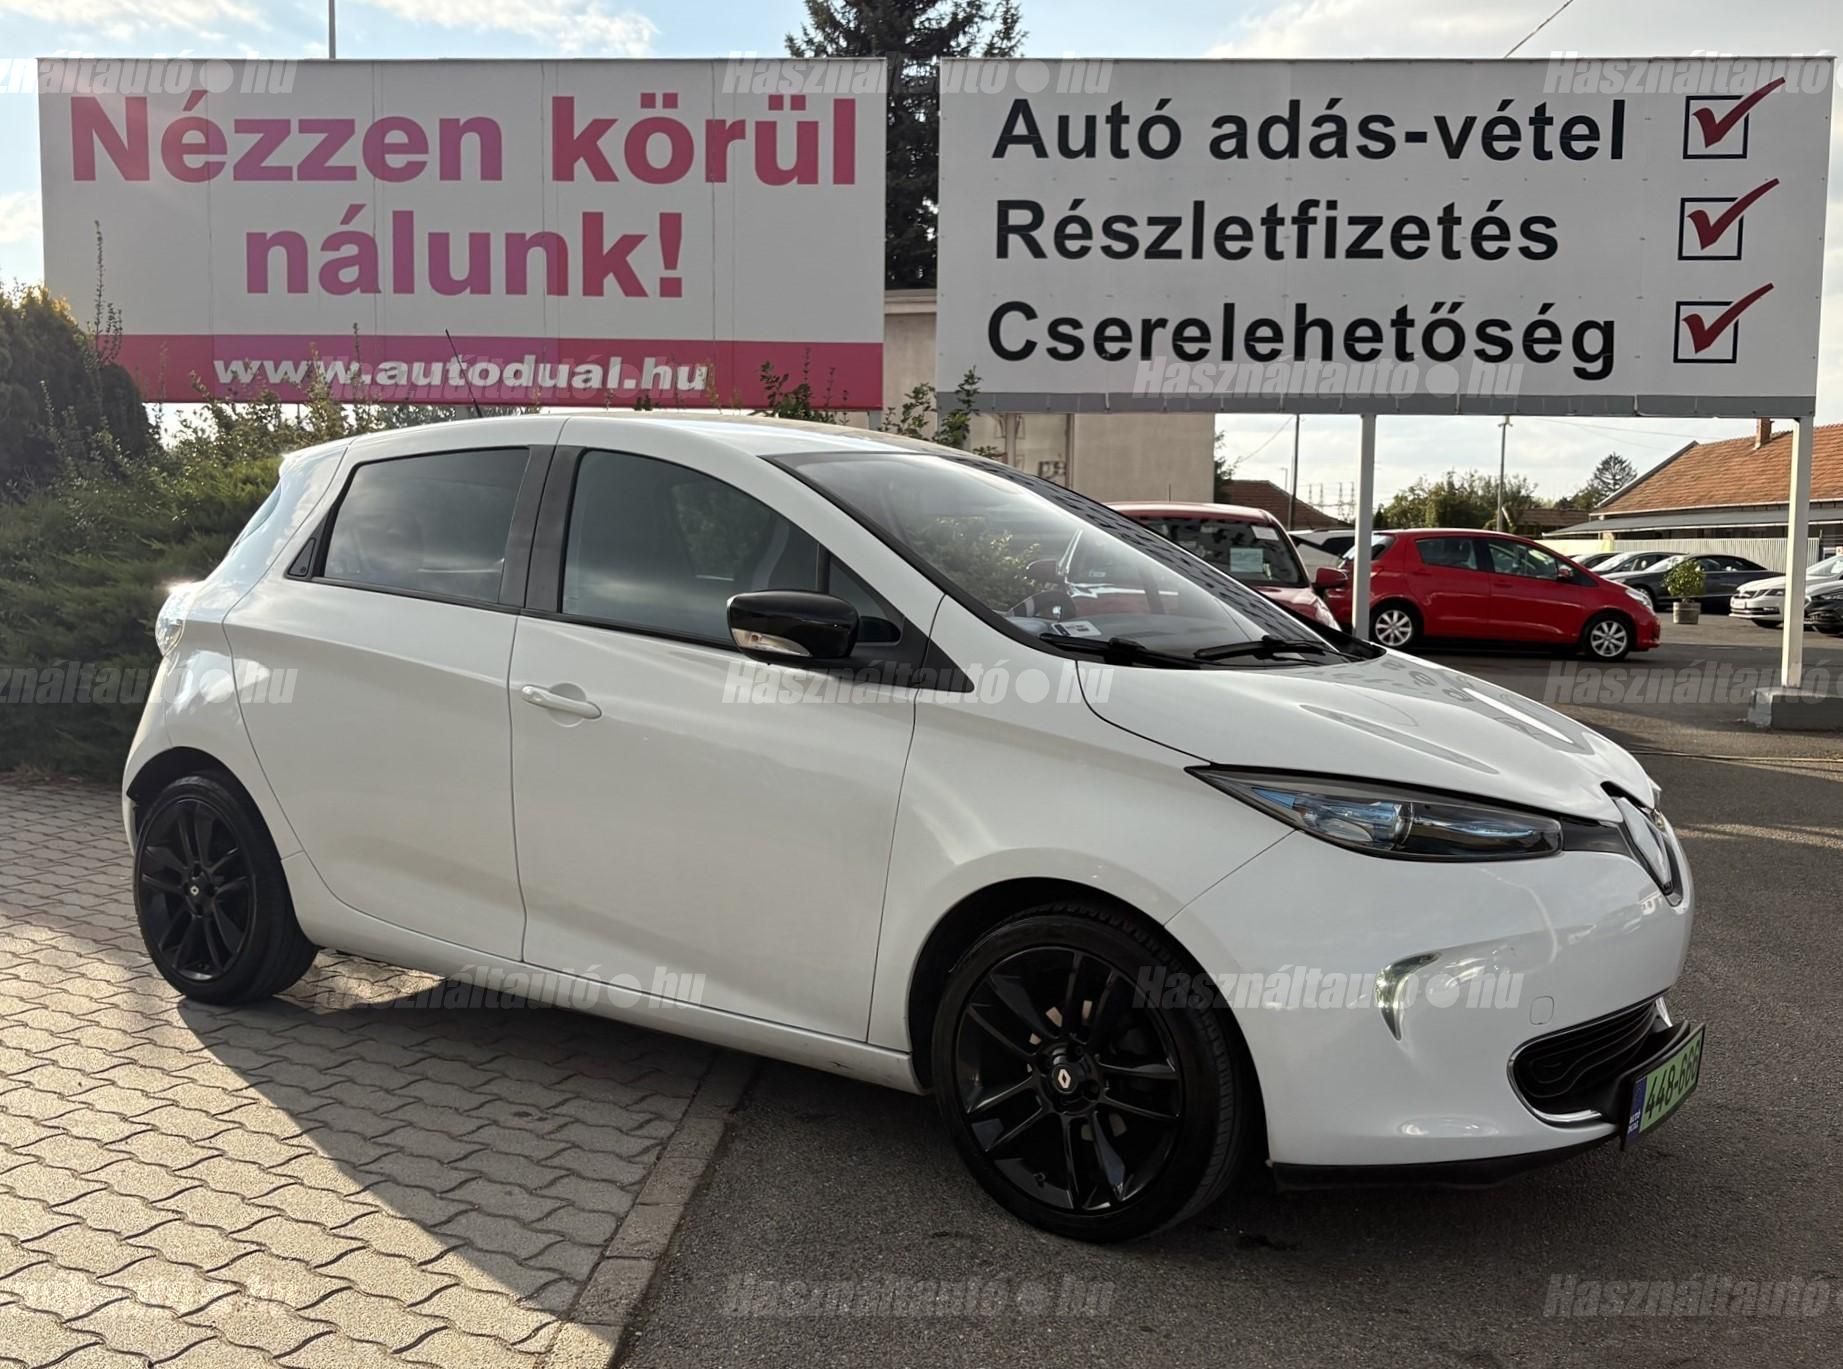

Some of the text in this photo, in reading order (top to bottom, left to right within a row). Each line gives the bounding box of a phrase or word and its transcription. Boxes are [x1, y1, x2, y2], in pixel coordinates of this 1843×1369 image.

[70, 92, 857, 185] Nézzen körül
[991, 98, 1627, 162] Autó adás-vétel
[246, 203, 682, 298] nálunk!
[995, 198, 1560, 261] Részletfizetés
[213, 353, 708, 392] www.autodual.hu
[987, 300, 1616, 381] Cserelehetőség
